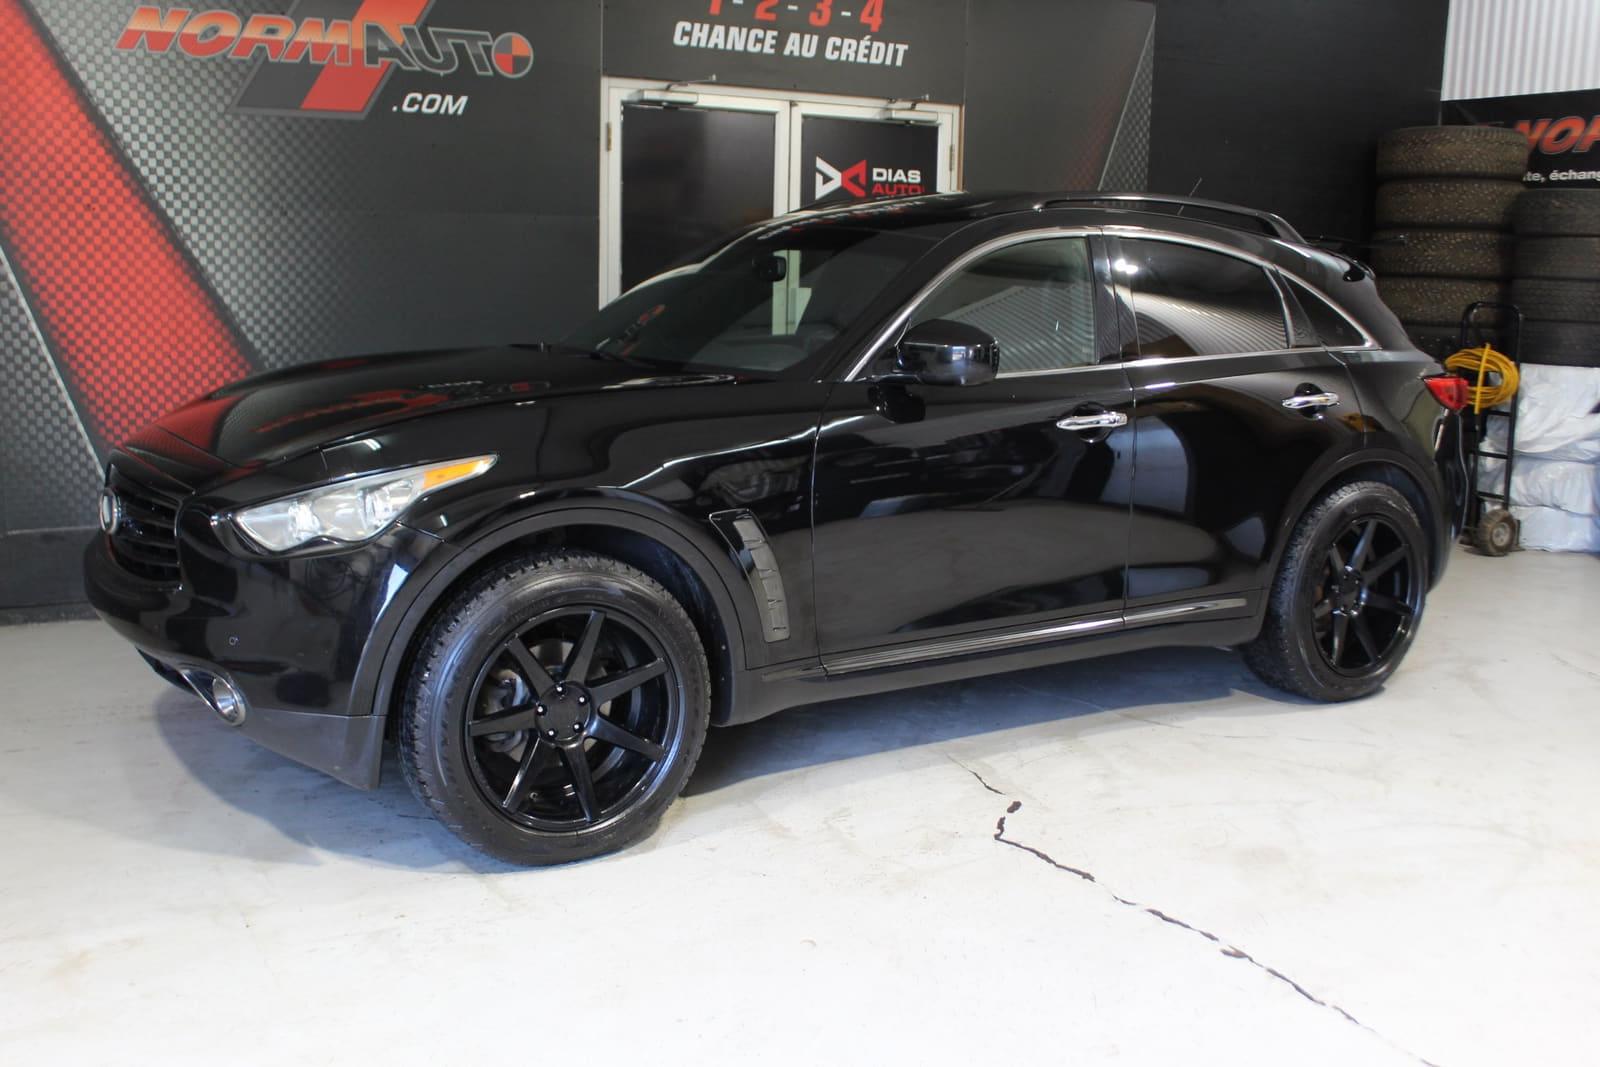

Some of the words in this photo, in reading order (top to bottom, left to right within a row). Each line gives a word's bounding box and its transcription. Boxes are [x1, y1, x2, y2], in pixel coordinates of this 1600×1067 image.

[673, 21, 778, 54] CHANCE
[783, 31, 819, 58] AU
[825, 35, 909, 67] CRÉDIT
[391, 92, 469, 116] .COM
[872, 168, 921, 183] DIAS
[872, 183, 922, 195] AUTO
